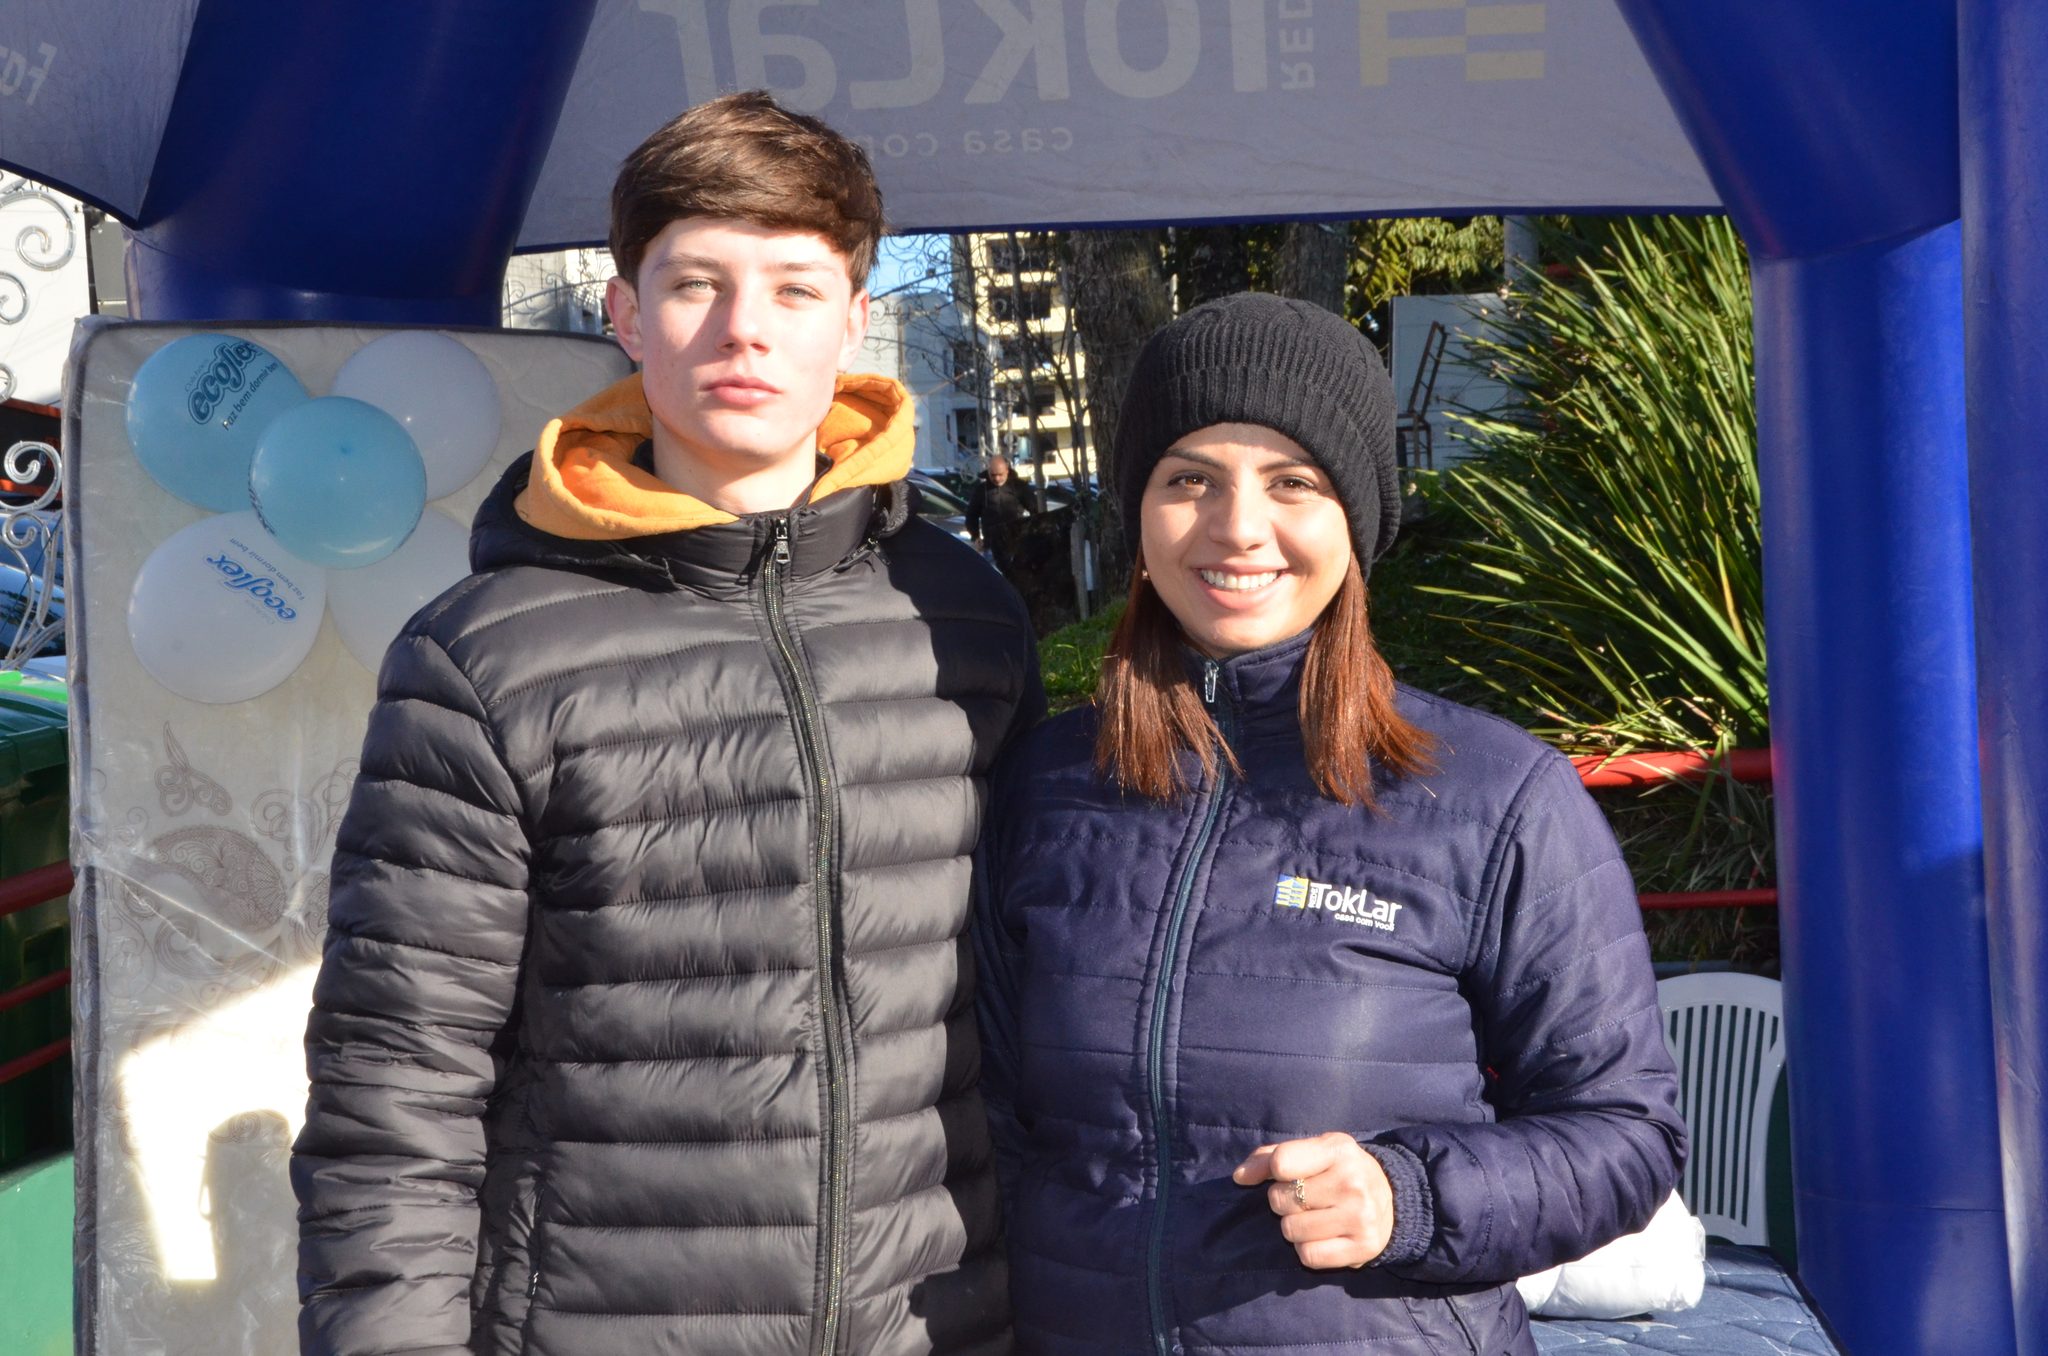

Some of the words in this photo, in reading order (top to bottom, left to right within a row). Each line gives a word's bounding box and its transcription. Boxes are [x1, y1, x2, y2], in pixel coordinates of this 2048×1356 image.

[233, 391, 252, 413] bem
[249, 551, 277, 573] dormir
[205, 554, 297, 620] ecoflex
[276, 571, 295, 589] bem
[1309, 882, 1402, 924] TokLar
[1335, 913, 1354, 922] casa
[1355, 916, 1374, 927] com
